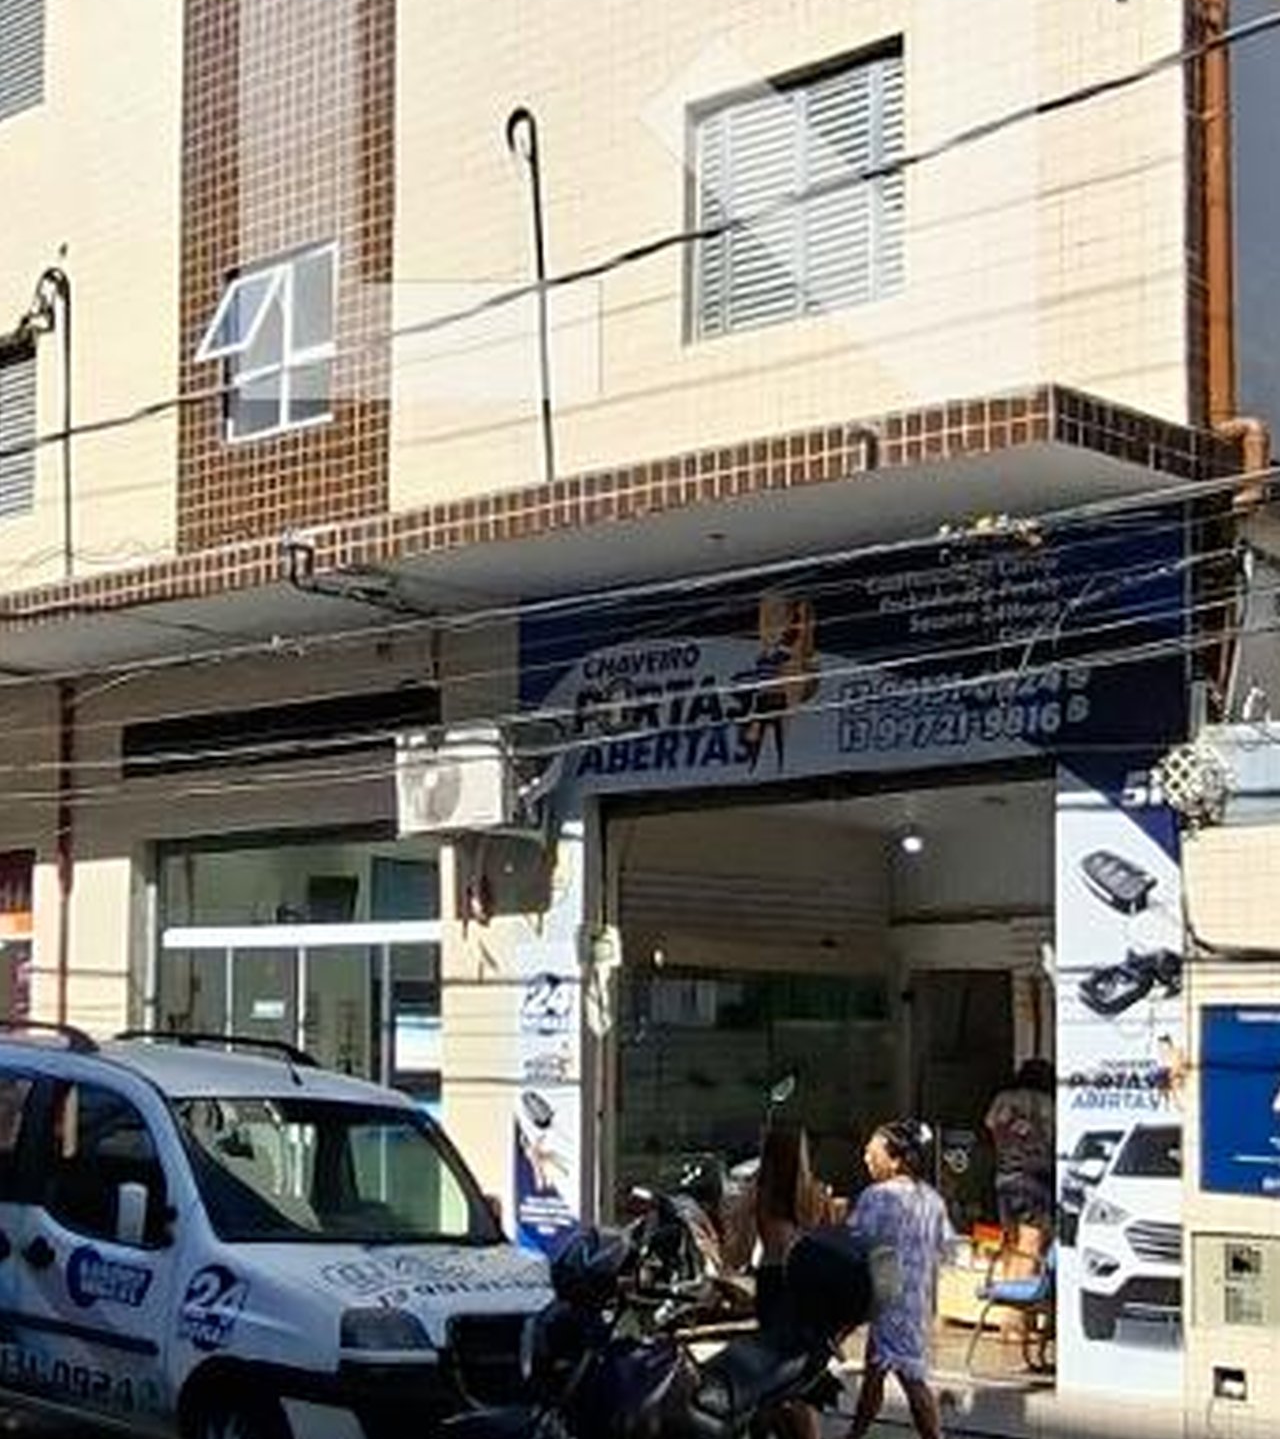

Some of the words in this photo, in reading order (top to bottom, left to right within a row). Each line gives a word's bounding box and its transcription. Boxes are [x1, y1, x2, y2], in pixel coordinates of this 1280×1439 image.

[583, 645, 701, 680] CHAVEIRO
[577, 722, 754, 777] ABERTAS
[183, 1272, 248, 1320] 24
